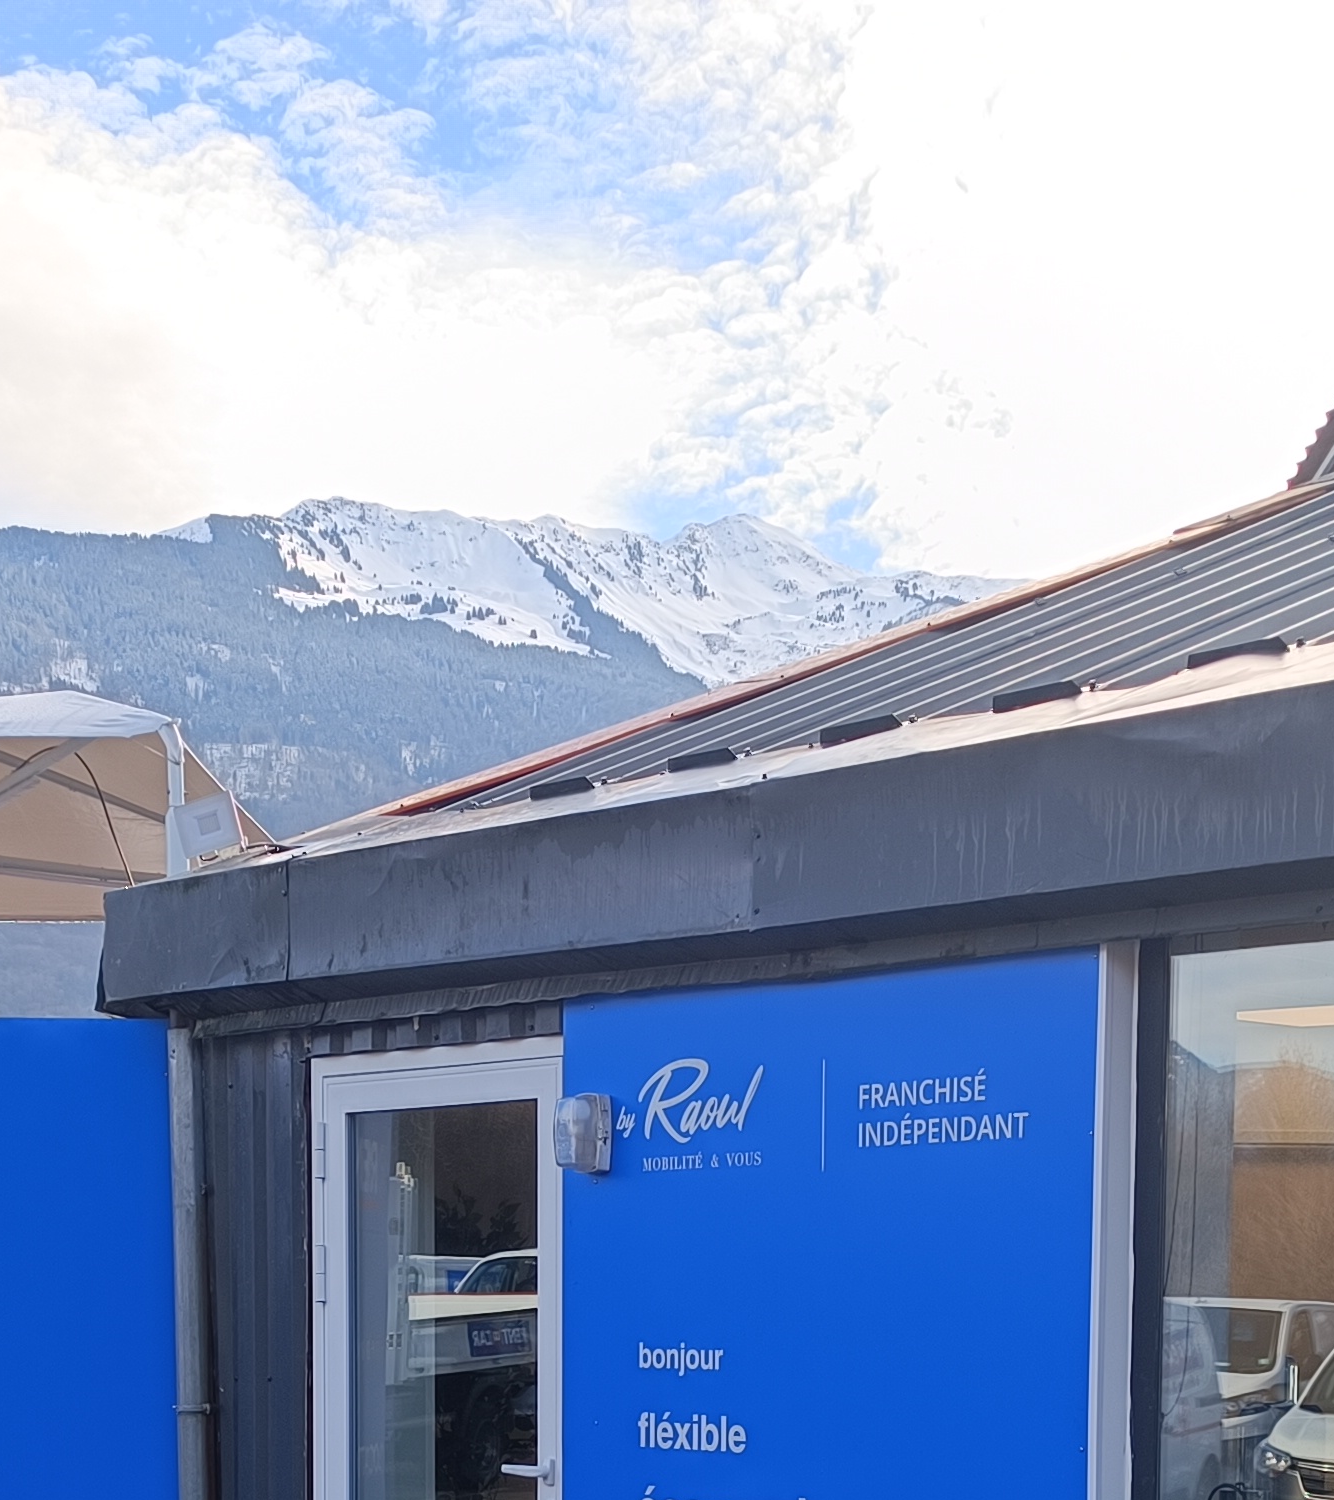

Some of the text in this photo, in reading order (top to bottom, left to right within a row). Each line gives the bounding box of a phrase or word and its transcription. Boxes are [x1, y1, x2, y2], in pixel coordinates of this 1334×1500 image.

[615, 1058, 764, 1144] by Raoul
[859, 1067, 987, 1110] FRANCHISÉ
[858, 1110, 1030, 1148] INDÉPENDANT
[643, 1151, 762, 1172] MOBILITÉ & VOUS
[638, 1341, 724, 1377] bonjour
[637, 1411, 747, 1454] fléxible
